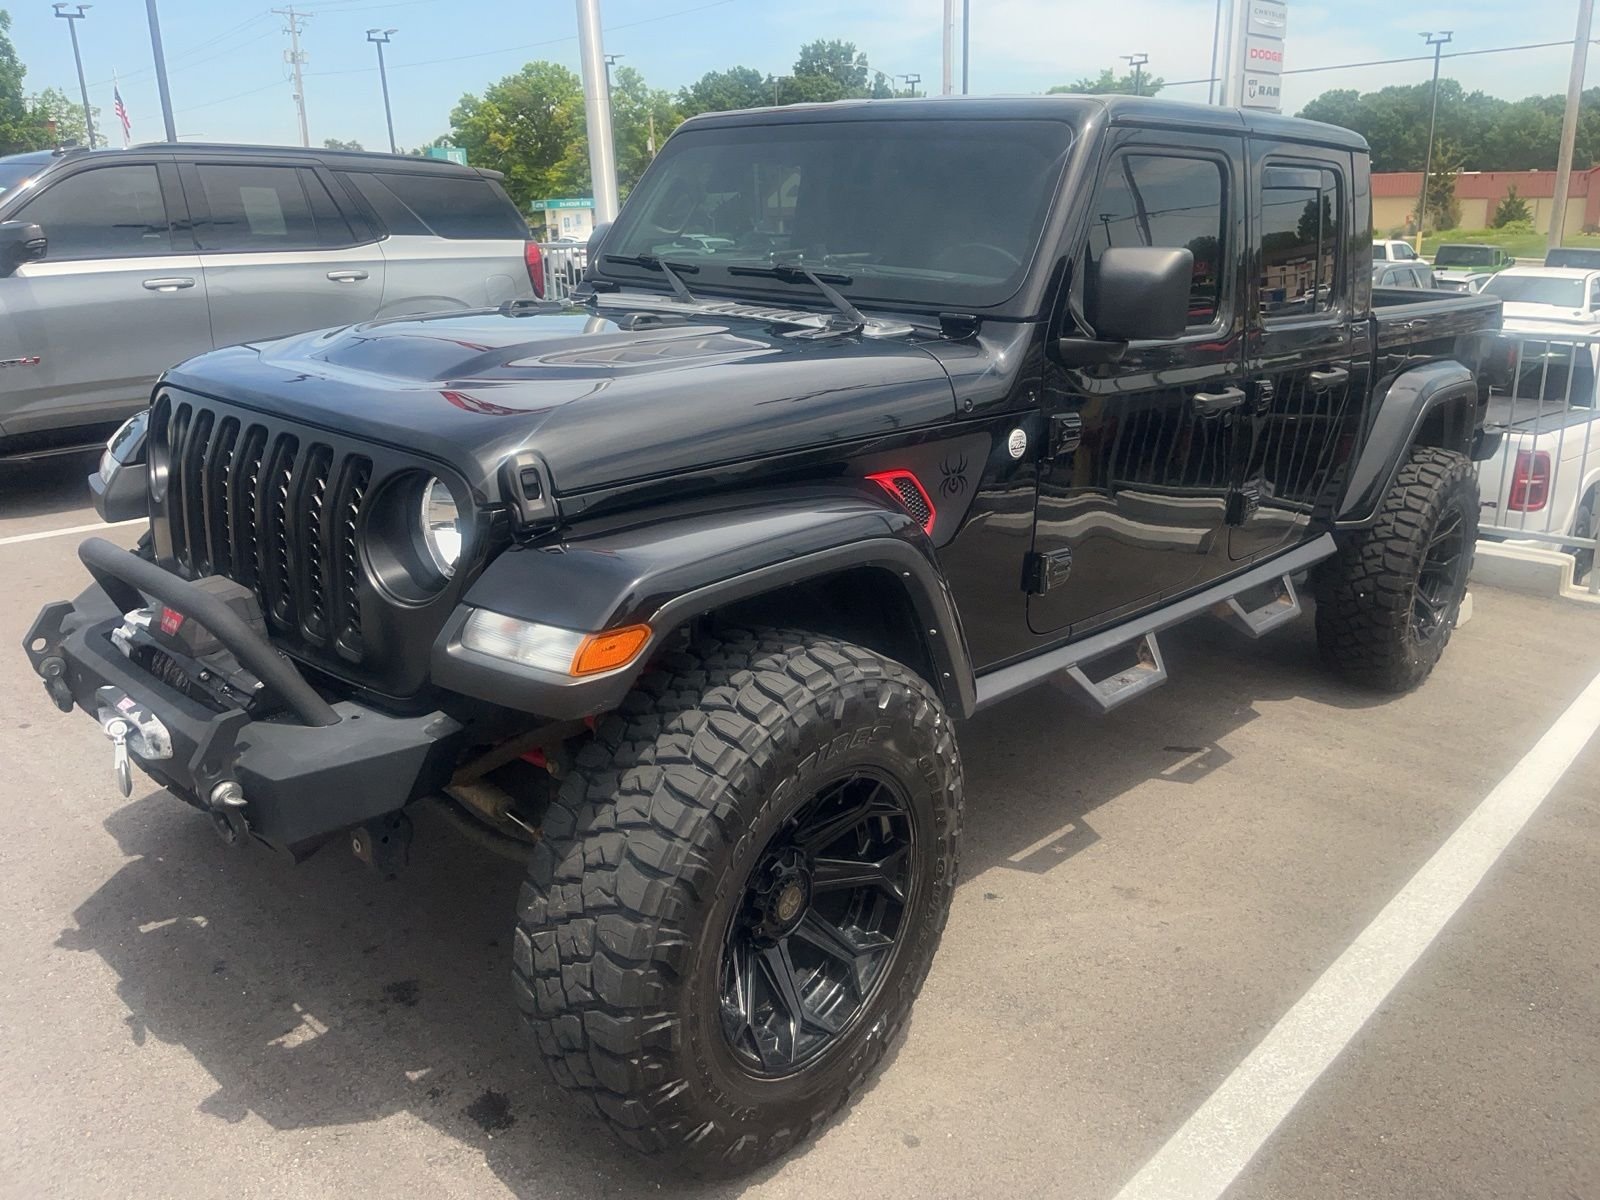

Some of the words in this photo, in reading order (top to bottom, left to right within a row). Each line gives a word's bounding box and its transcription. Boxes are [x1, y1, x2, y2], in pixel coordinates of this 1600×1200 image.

[1254, 8, 1286, 19] CHRYSLER
[1250, 48, 1282, 62] DODGE
[1258, 86, 1280, 97] RAM
